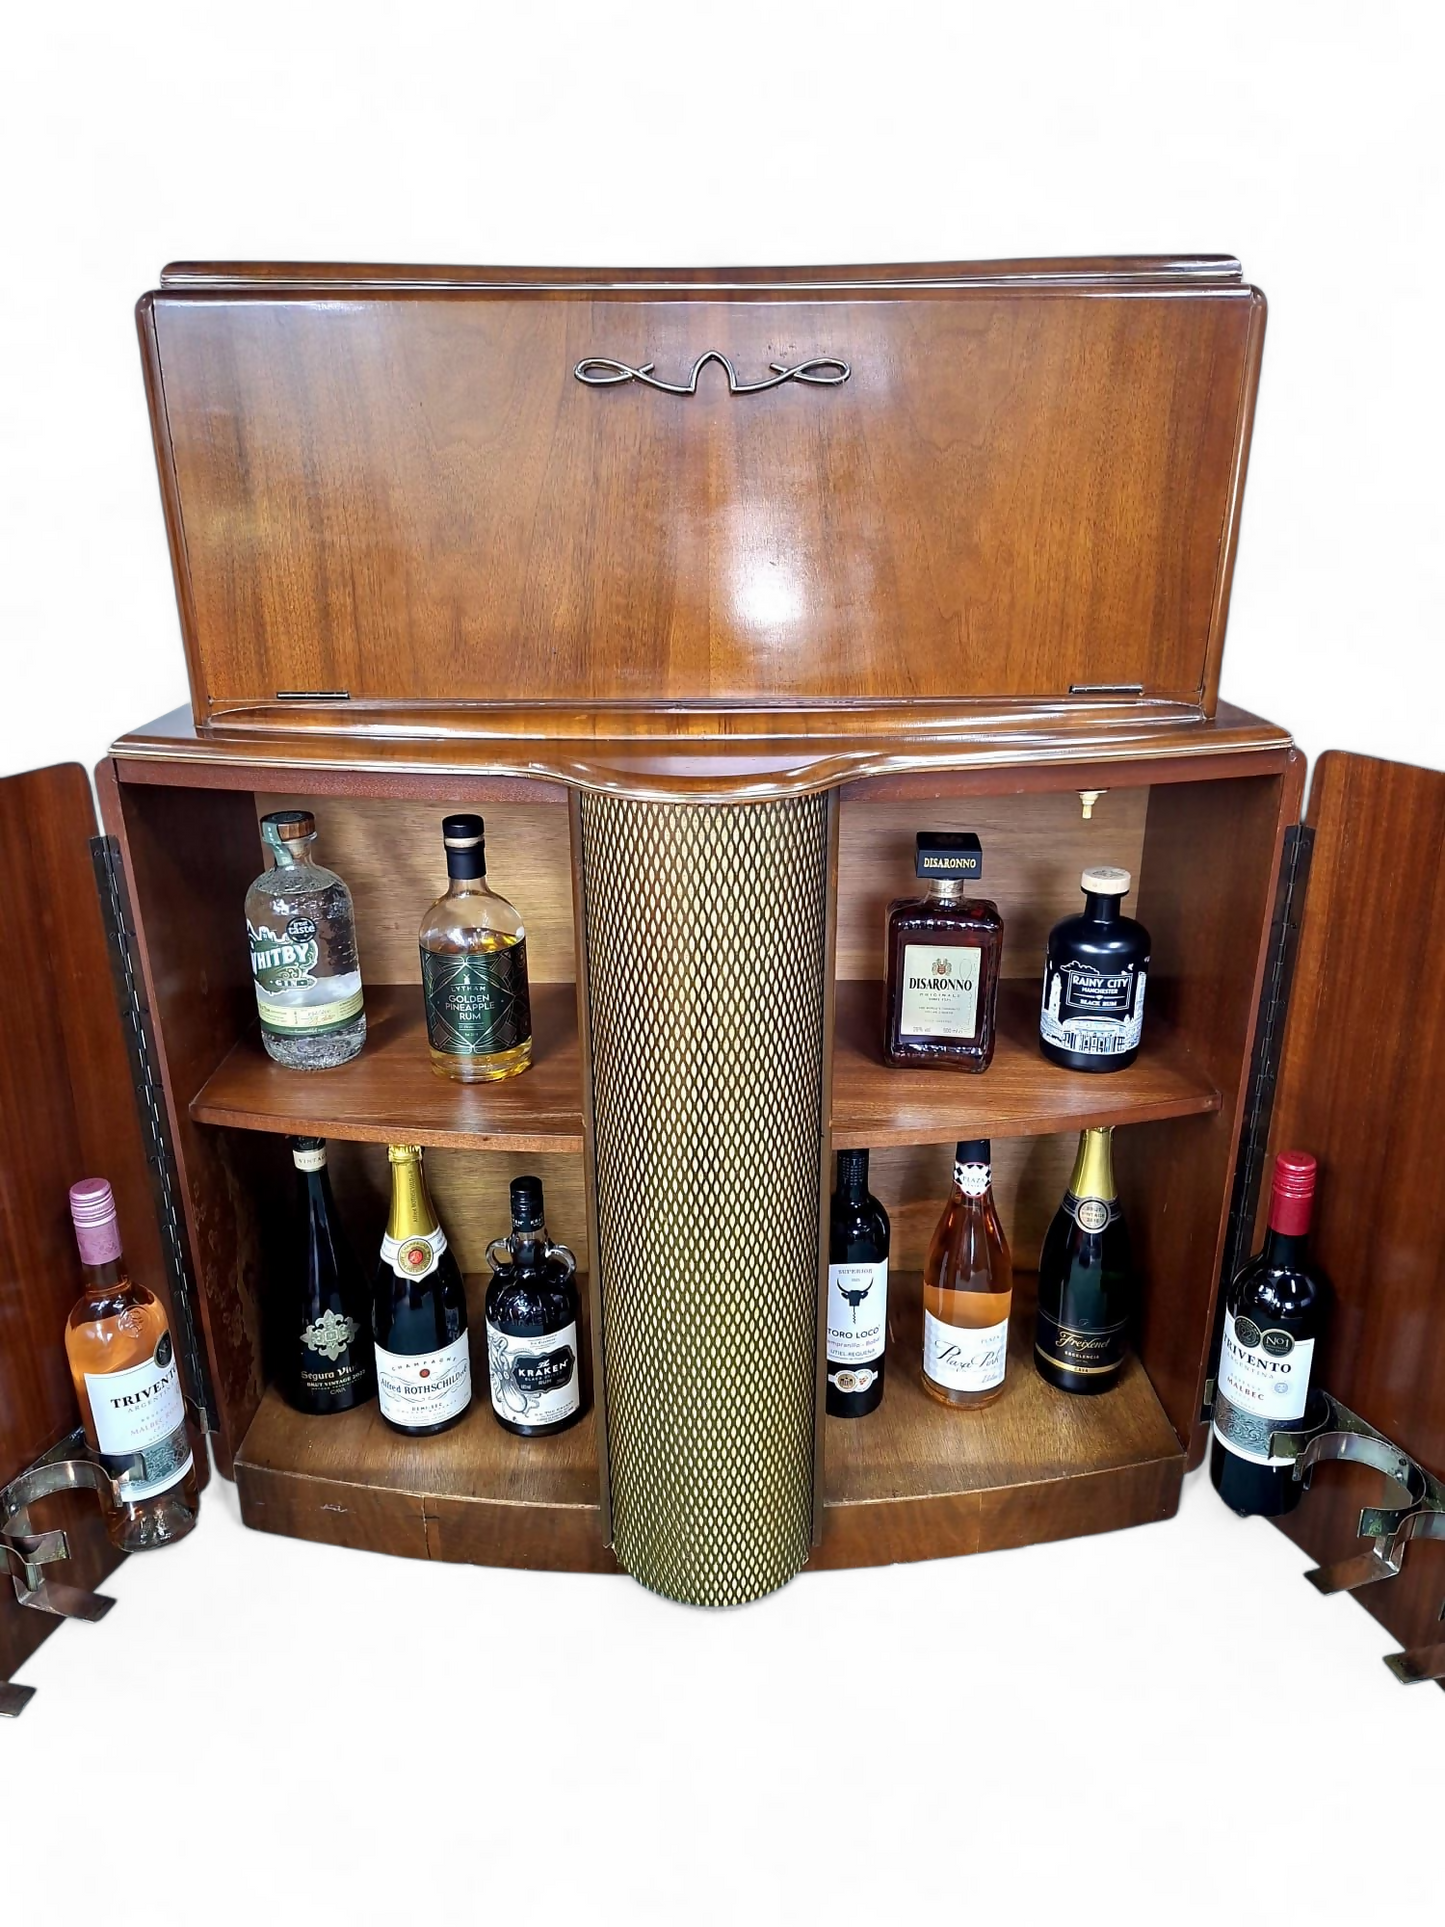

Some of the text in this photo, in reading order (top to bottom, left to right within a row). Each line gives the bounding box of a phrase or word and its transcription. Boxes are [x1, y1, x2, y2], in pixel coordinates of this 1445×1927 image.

[924, 857, 977, 869] DISARONNO
[288, 925, 316, 935] taste
[275, 979, 297, 987] GIN
[909, 977, 973, 991] DISARONNO
[1072, 975, 1129, 988] RAINY CITY
[448, 994, 490, 1004] GOLDEN
[445, 1001, 496, 1011] PINEAPPLE
[459, 1012, 481, 1020] RUM
[827, 1326, 880, 1339] TORO LOCO
[1055, 1331, 1111, 1351] Freixenet
[391, 1357, 457, 1371] CHAMPAGNE
[518, 1360, 568, 1377] KRAKEN
[300, 1370, 335, 1381] Segura
[324, 1376, 351, 1386] VINTAGE
[380, 1378, 401, 1393] Alfred
[404, 1372, 460, 1395] ROTHSCHILD
[1226, 1375, 1265, 1401] MALBEC
[330, 1387, 347, 1395] CAVA
[411, 1402, 443, 1412] DEMI-SEC
